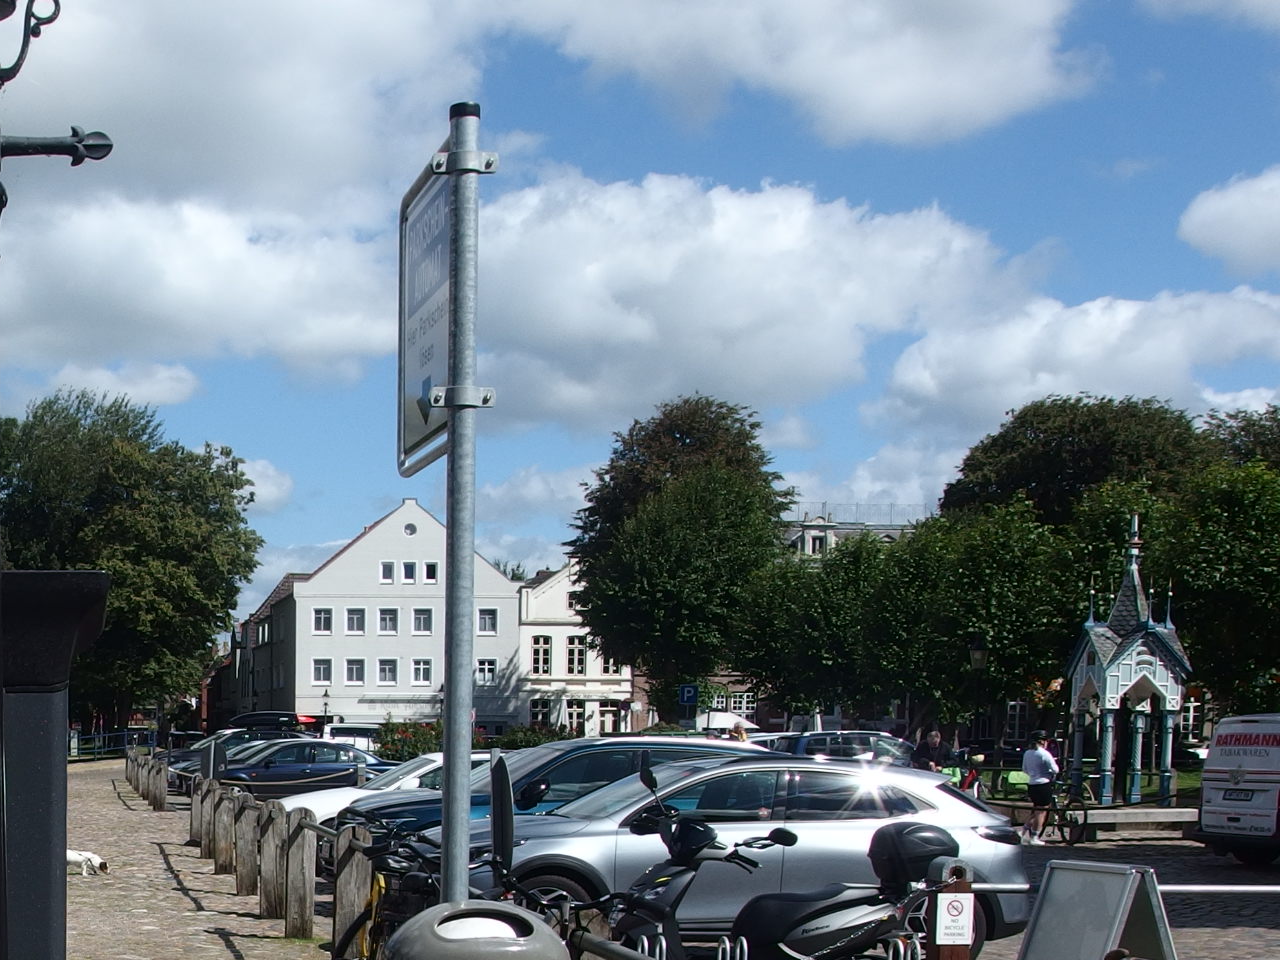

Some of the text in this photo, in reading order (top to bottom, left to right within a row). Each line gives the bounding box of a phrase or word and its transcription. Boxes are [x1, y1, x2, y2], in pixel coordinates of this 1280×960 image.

[414, 244, 442, 306] AUTOMAT
[684, 687, 695, 701] P
[1215, 732, 1280, 747] RATHMANN
[1220, 748, 1270, 757] TABAKWAREN
